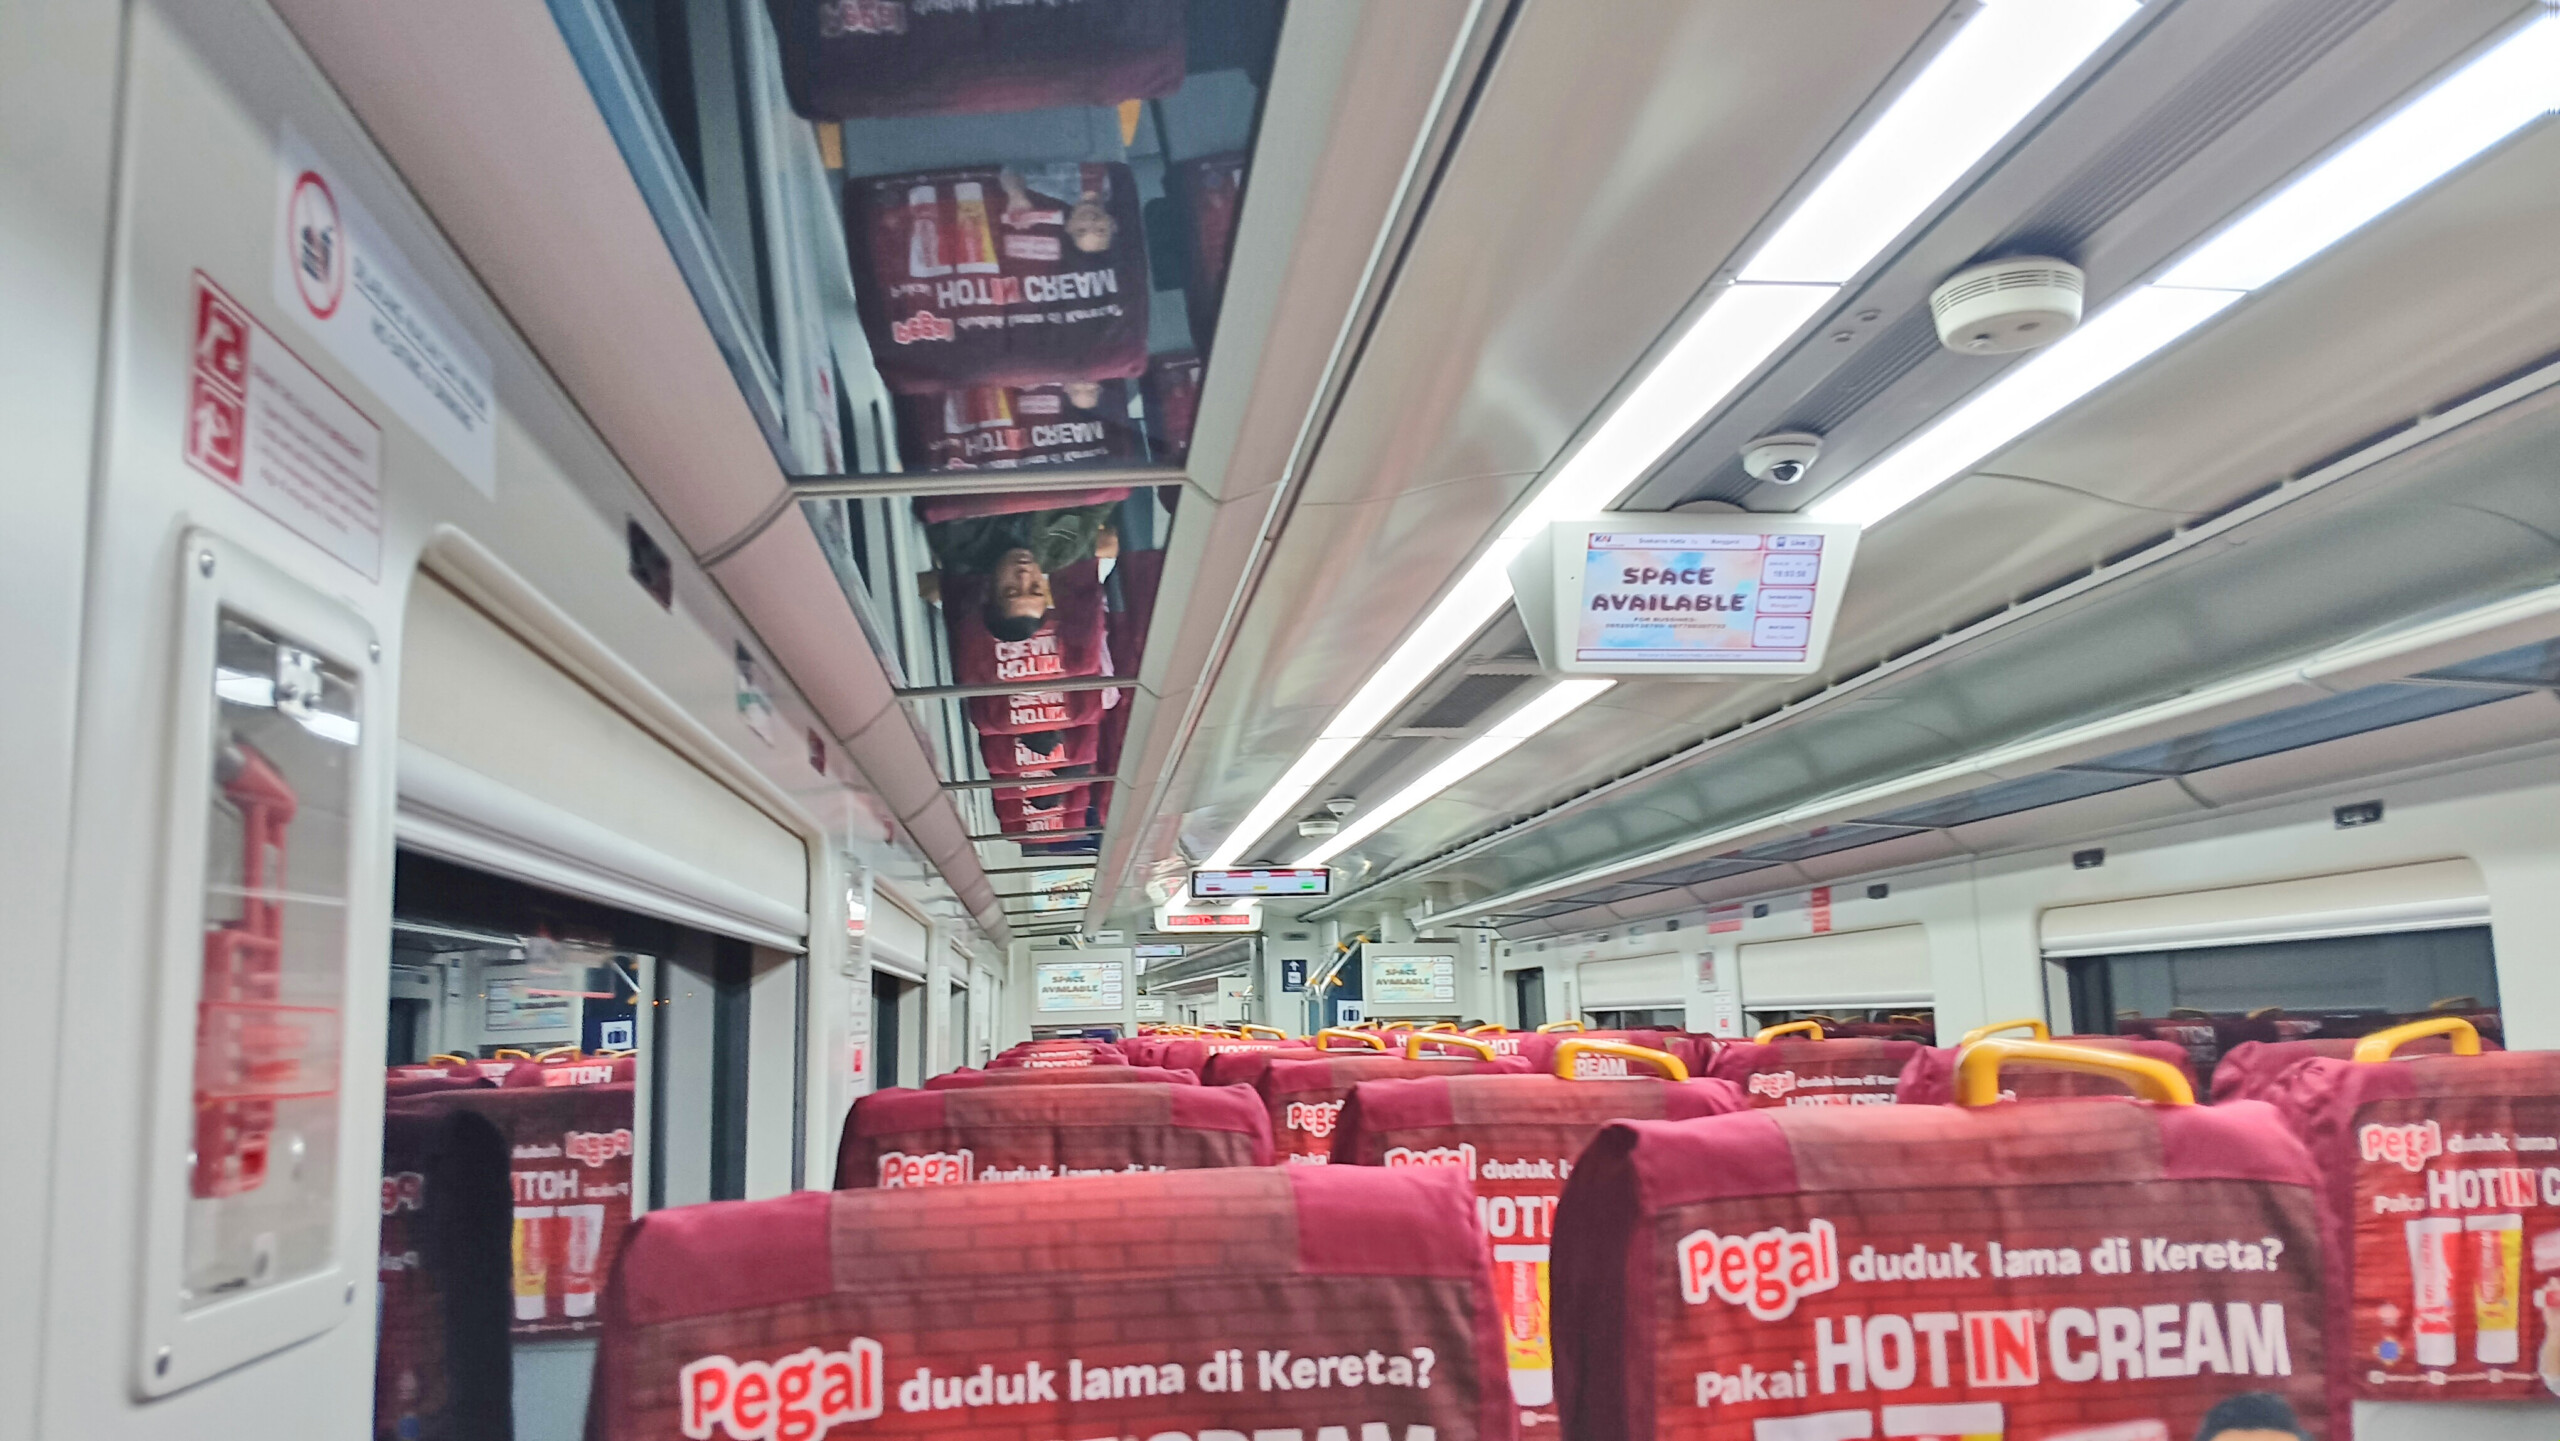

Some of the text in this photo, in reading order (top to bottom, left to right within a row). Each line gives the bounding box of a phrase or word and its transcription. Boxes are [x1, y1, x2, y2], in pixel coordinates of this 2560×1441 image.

[1622, 567, 1715, 585] SPACE
[1591, 594, 1747, 612] AVAILABLE
[1575, 1058, 1628, 1077] REAM
[2360, 1119, 2442, 1172] Pegal
[1481, 1158, 1557, 1180] duduk
[2427, 1167, 2500, 1209] HOT
[1677, 1218, 2284, 1321] Pegal duduk lama di Kereta?
[1696, 1301, 2291, 1408] Pakai HOT IN CREAM
[680, 1336, 1436, 1441] Pegal duduk lama di Kereta?
